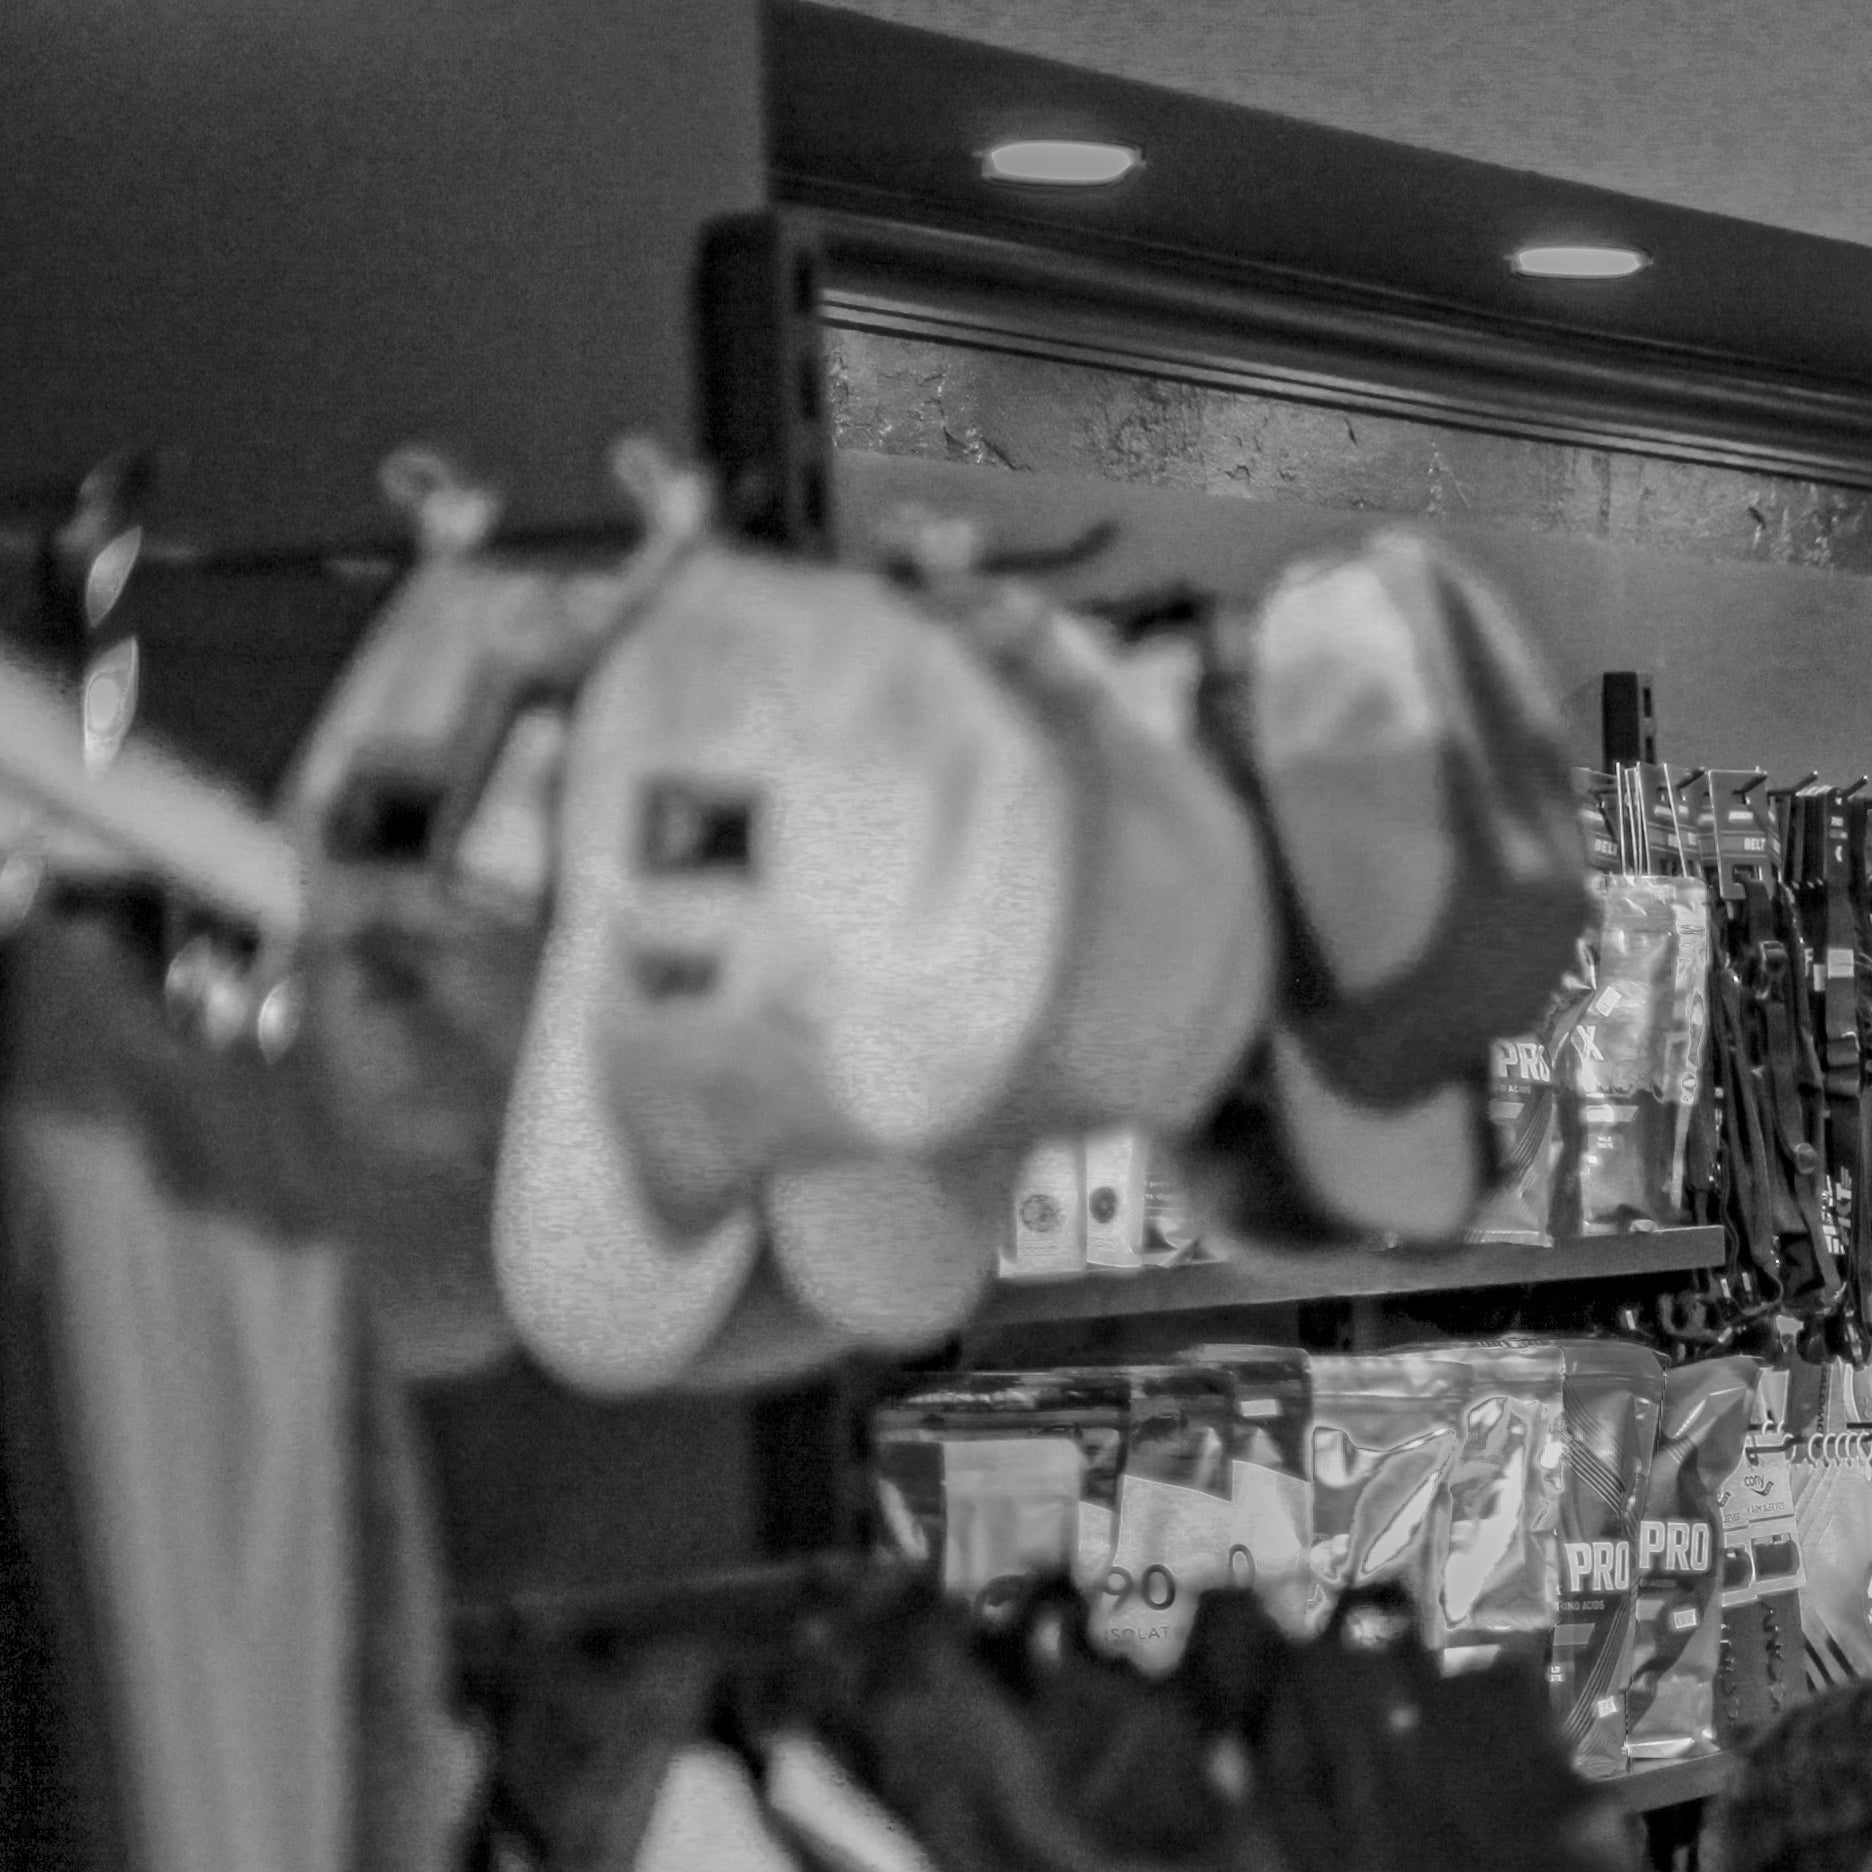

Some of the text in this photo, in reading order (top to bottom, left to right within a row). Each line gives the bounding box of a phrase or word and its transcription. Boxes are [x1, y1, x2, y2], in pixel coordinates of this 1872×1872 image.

[1563, 1540, 1630, 1593] PRO
[1638, 1520, 1710, 1572] PRO
[1104, 1563, 1176, 1611] 90
